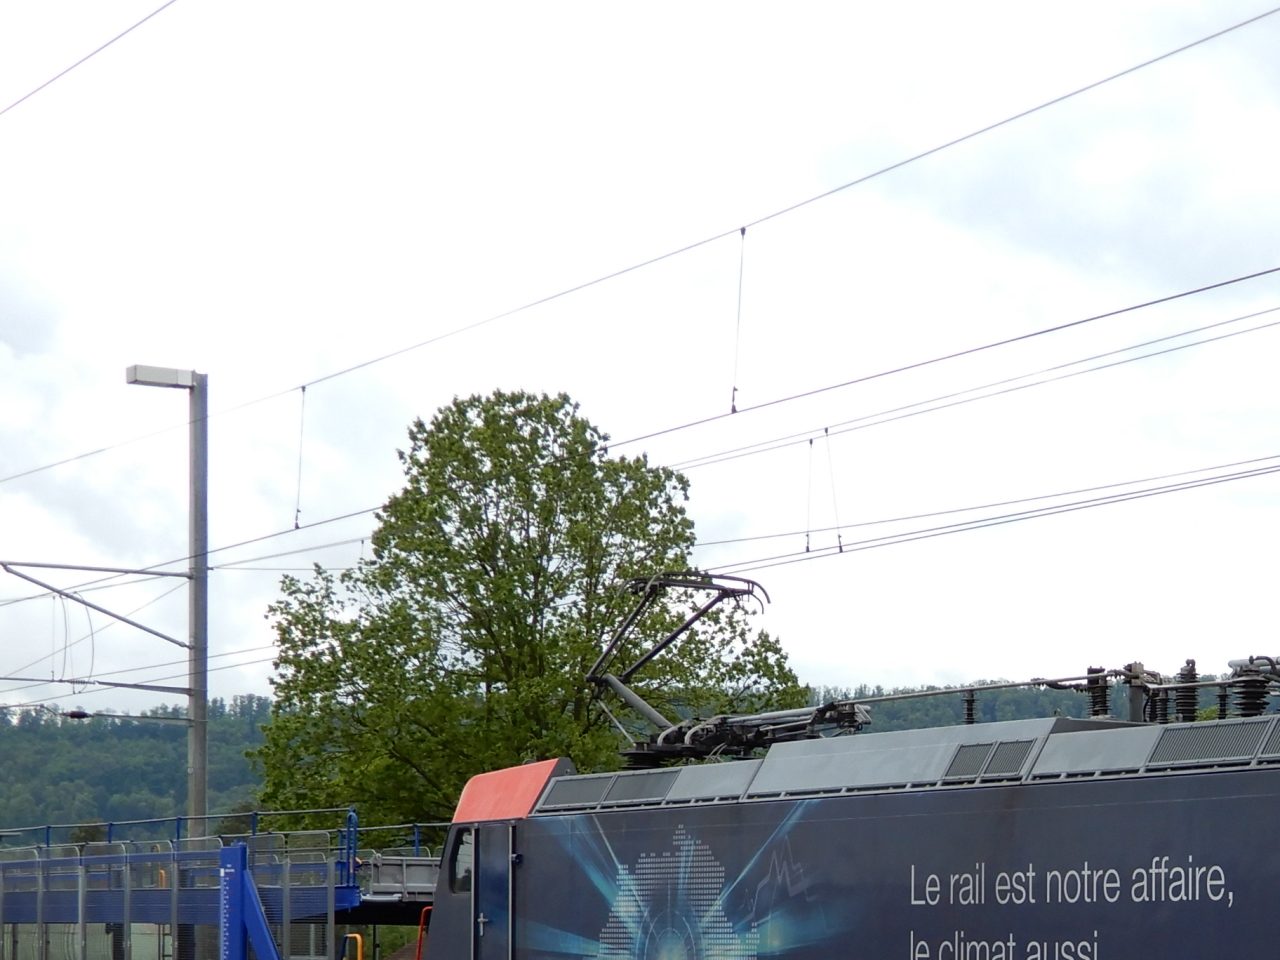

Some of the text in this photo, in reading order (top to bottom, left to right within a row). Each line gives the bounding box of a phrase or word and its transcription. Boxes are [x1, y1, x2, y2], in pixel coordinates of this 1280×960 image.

[910, 854, 1234, 909] Le rail est notre affaire,
